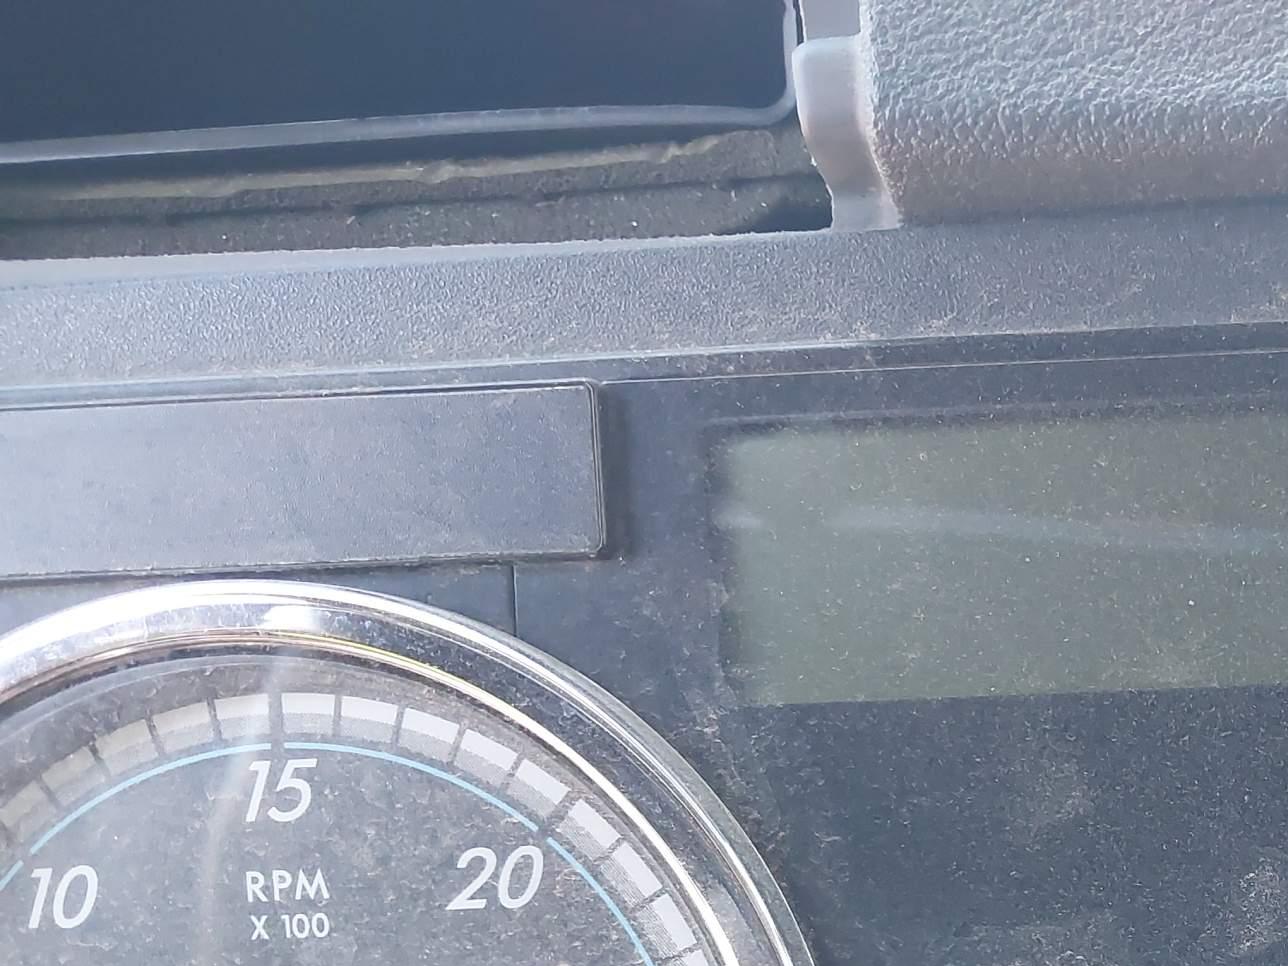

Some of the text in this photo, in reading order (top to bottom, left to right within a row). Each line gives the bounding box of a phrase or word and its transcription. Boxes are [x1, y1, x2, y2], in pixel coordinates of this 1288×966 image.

[243, 759, 317, 823] 15
[28, 865, 98, 929] 10
[246, 870, 330, 901] RPM
[446, 845, 543, 912] 20
[250, 913, 330, 940] X 100
